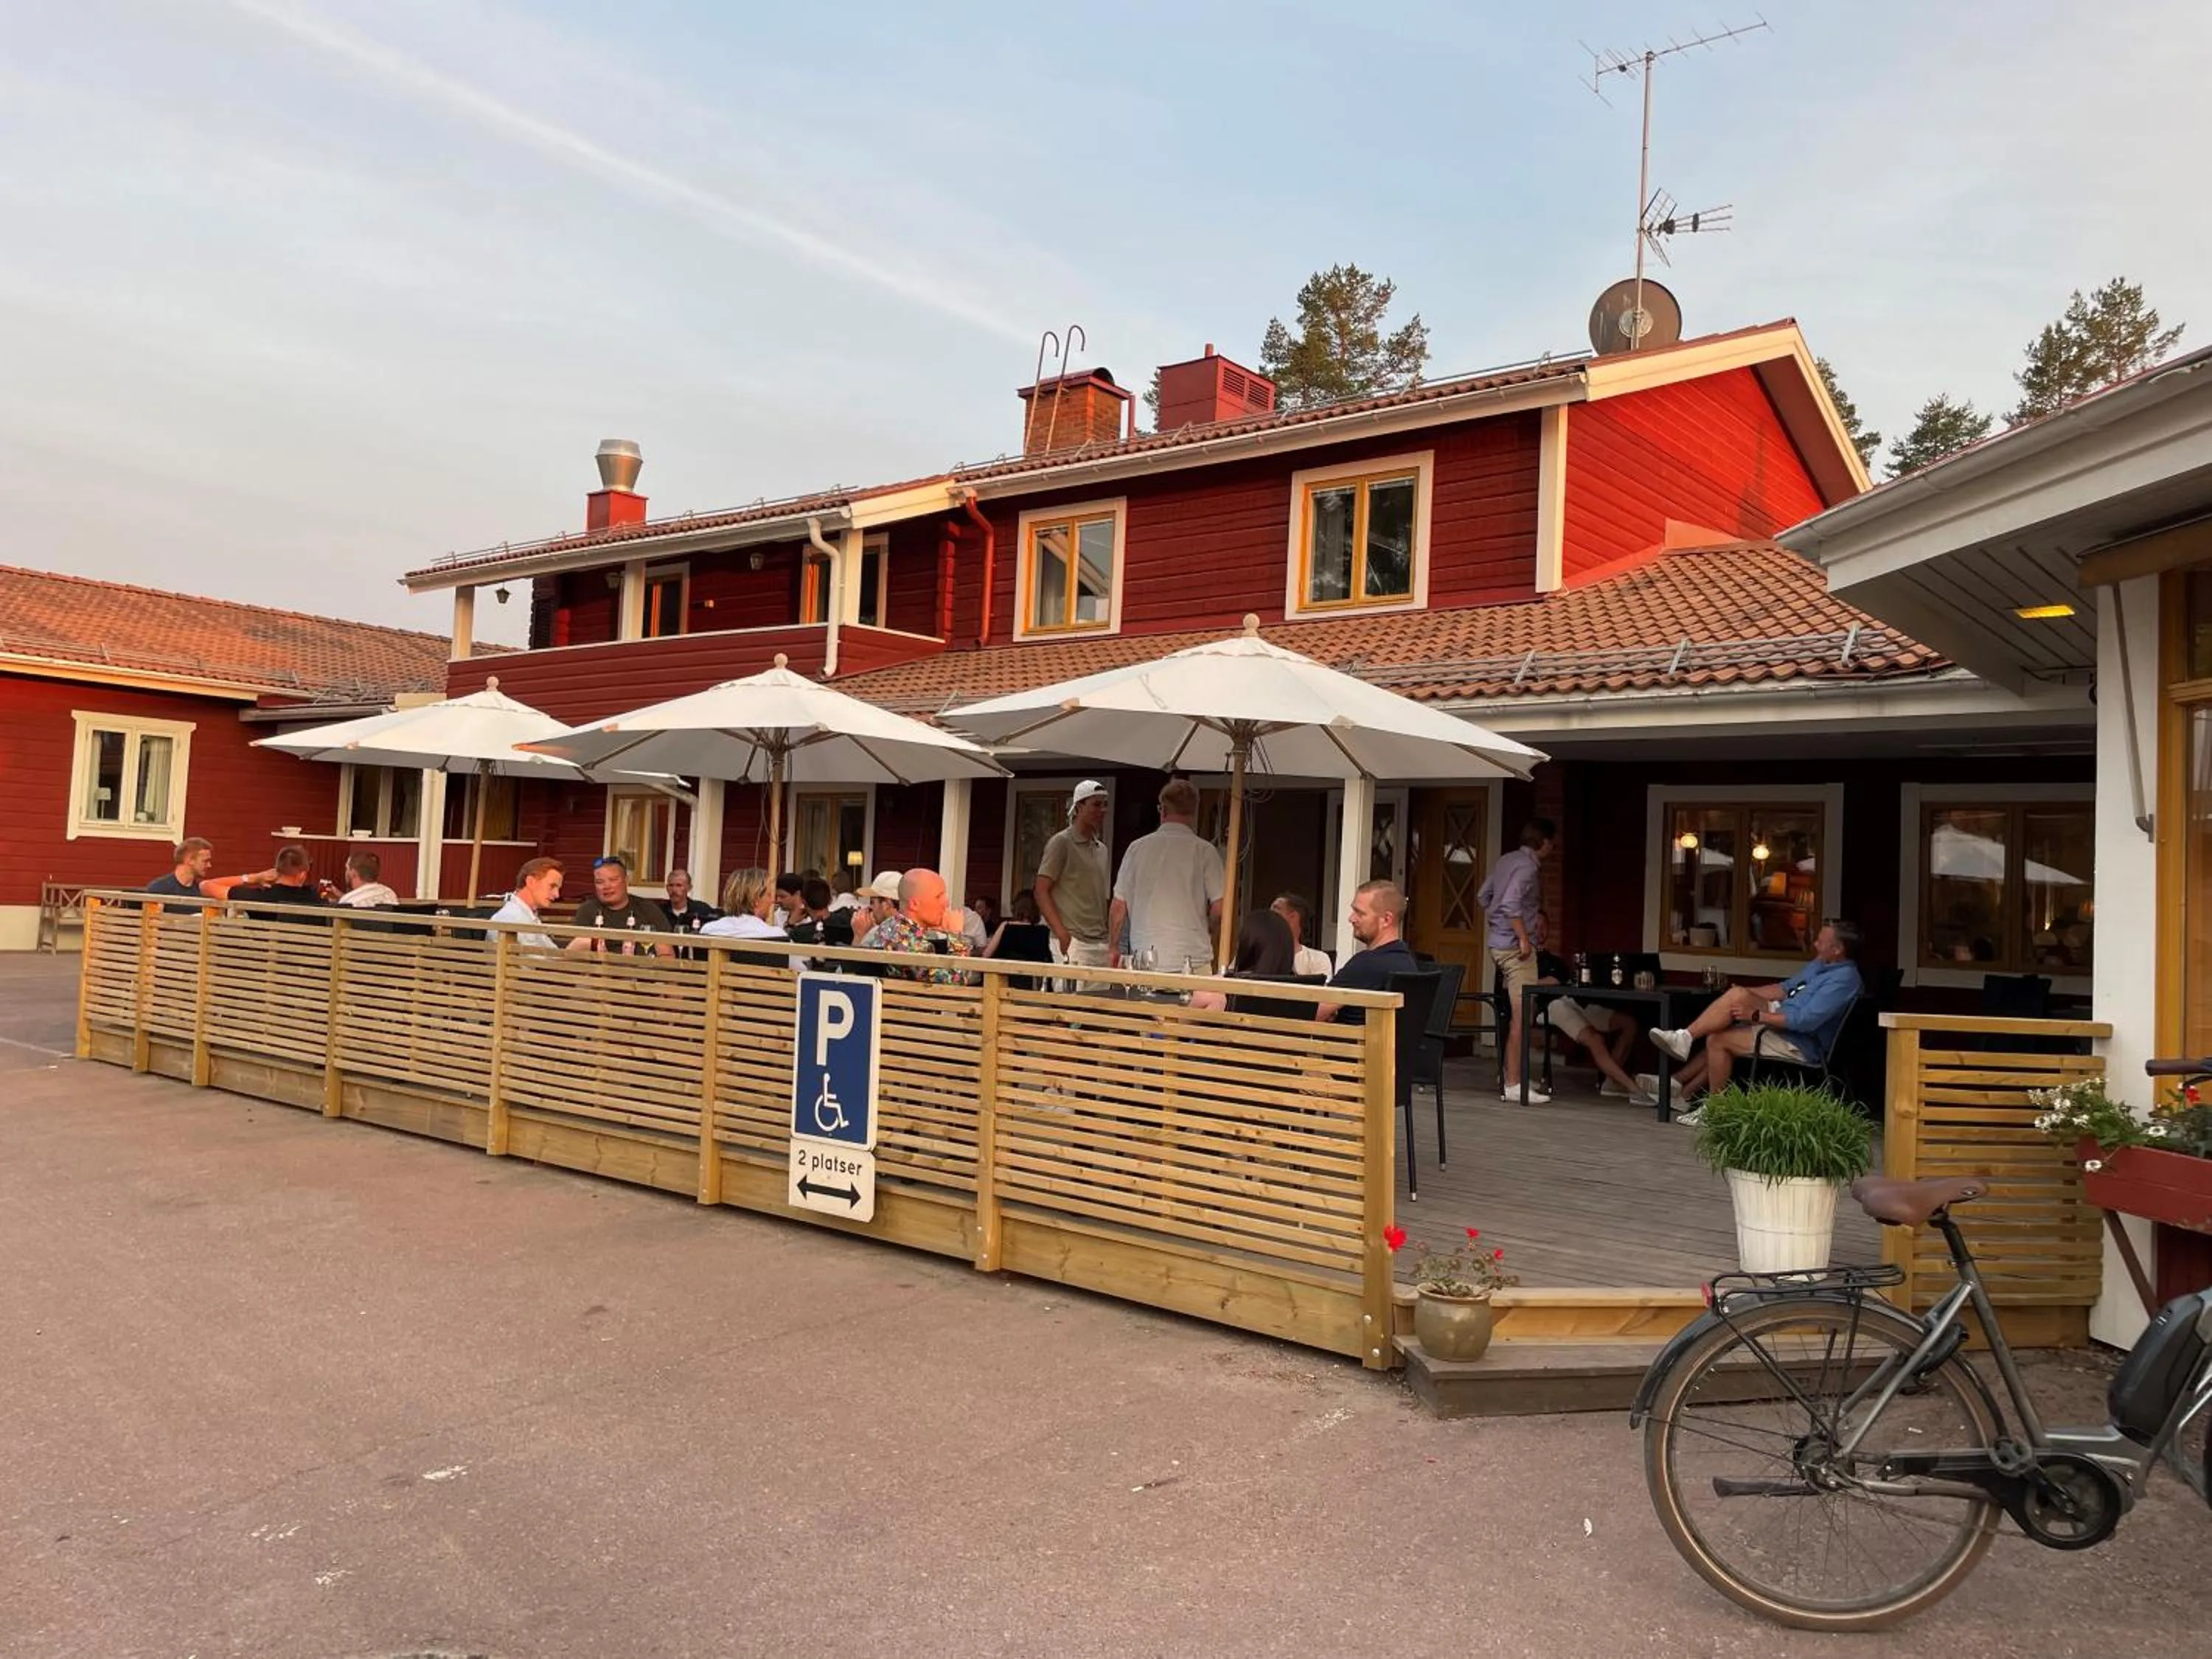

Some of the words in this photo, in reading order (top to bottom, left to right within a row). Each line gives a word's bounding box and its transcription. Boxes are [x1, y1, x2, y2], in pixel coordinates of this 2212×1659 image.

[816, 989, 855, 1066] P
[798, 1150, 806, 1166] 2
[812, 1152, 862, 1176] platser
